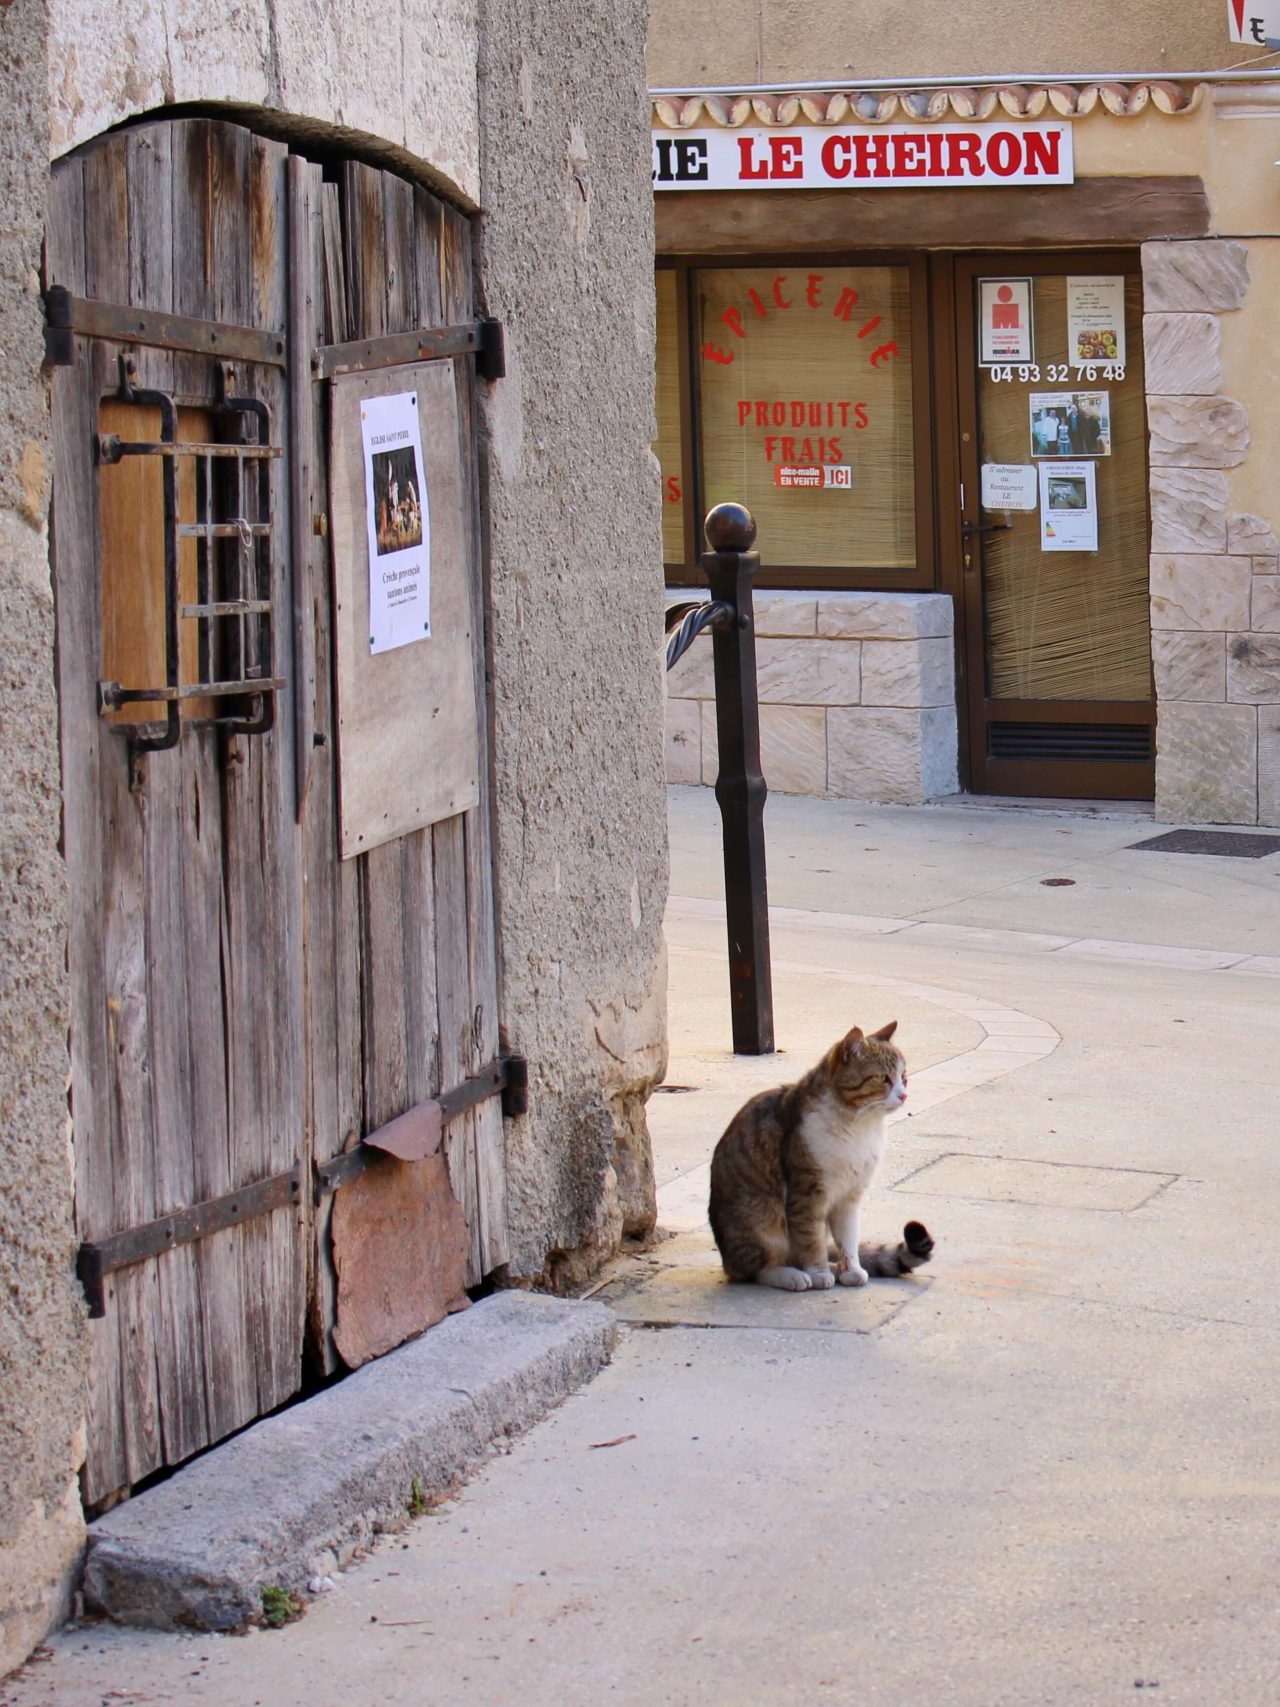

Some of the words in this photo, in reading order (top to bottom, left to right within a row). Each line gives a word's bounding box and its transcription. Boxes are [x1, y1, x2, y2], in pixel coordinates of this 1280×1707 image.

[653, 139, 708, 181] IE
[737, 136, 803, 180] LE
[821, 131, 1061, 178] CHEIRON
[701, 274, 899, 369] EPICERIE
[990, 365, 1013, 383] 04
[1018, 365, 1041, 382] 93
[1046, 364, 1069, 382] 32
[1075, 364, 1097, 382] 76
[1102, 364, 1125, 381] 48
[737, 401, 869, 429] PRODUITS
[765, 436, 843, 463] FRAIS
[781, 477, 792, 486] EN
[794, 477, 820, 486] VENTE
[830, 470, 849, 485] ICI
